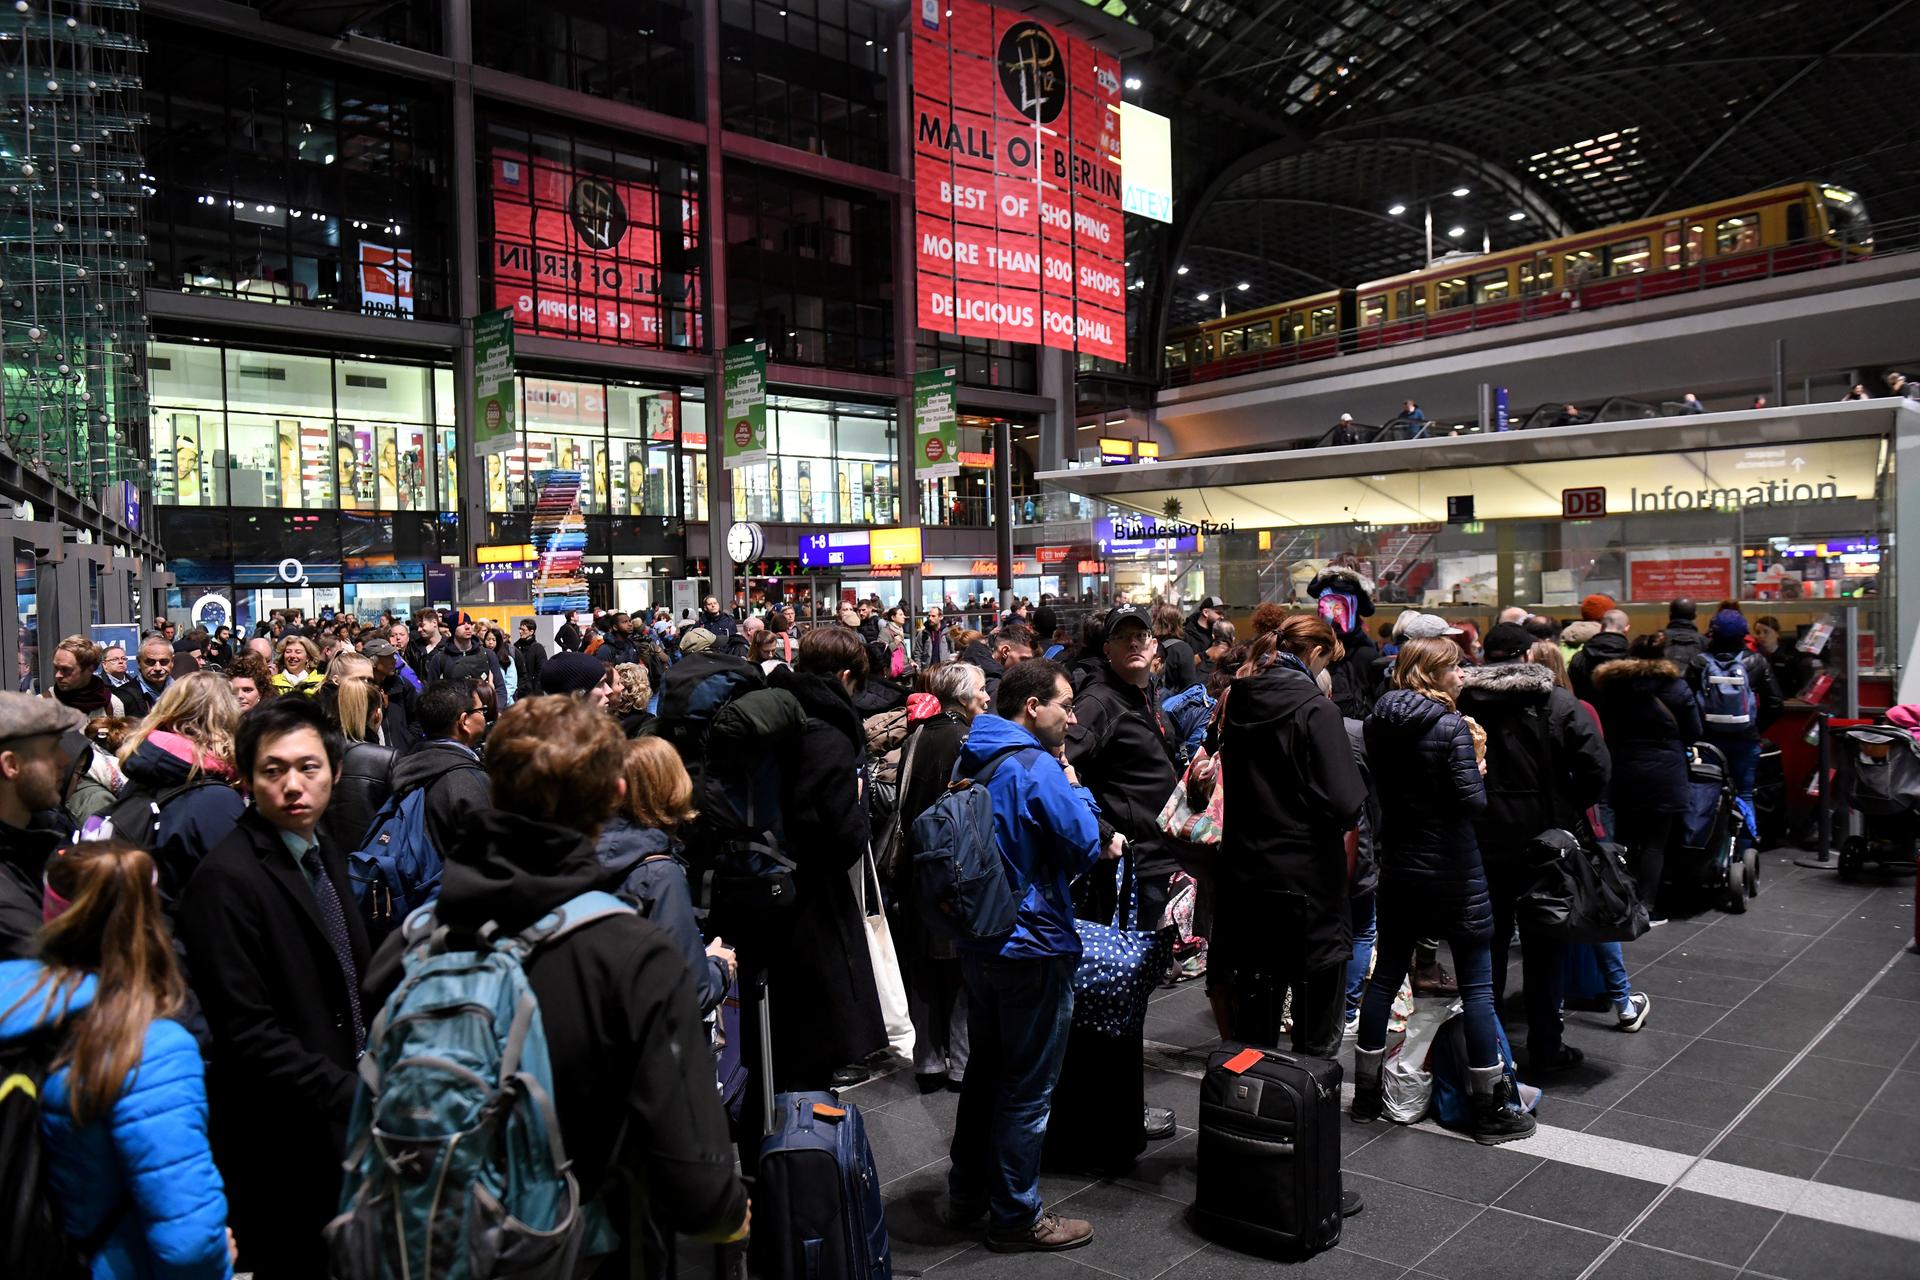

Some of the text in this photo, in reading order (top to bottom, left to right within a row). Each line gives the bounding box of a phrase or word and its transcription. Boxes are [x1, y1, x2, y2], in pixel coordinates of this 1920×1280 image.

[919, 112, 995, 160] MALL
[1007, 136, 1045, 170] OF
[1054, 148, 1121, 201] BERLIN
[940, 181, 1111, 243] BEST OF SHOPPING
[923, 233, 1121, 297] MORE THAN 300 SHOPS
[932, 293, 1113, 345] DELICIOUS FOODHALL
[1566, 478, 1837, 514] DB Information
[810, 534, 826, 549] 1-8
[1115, 518, 1235, 541] Bundespolizei
